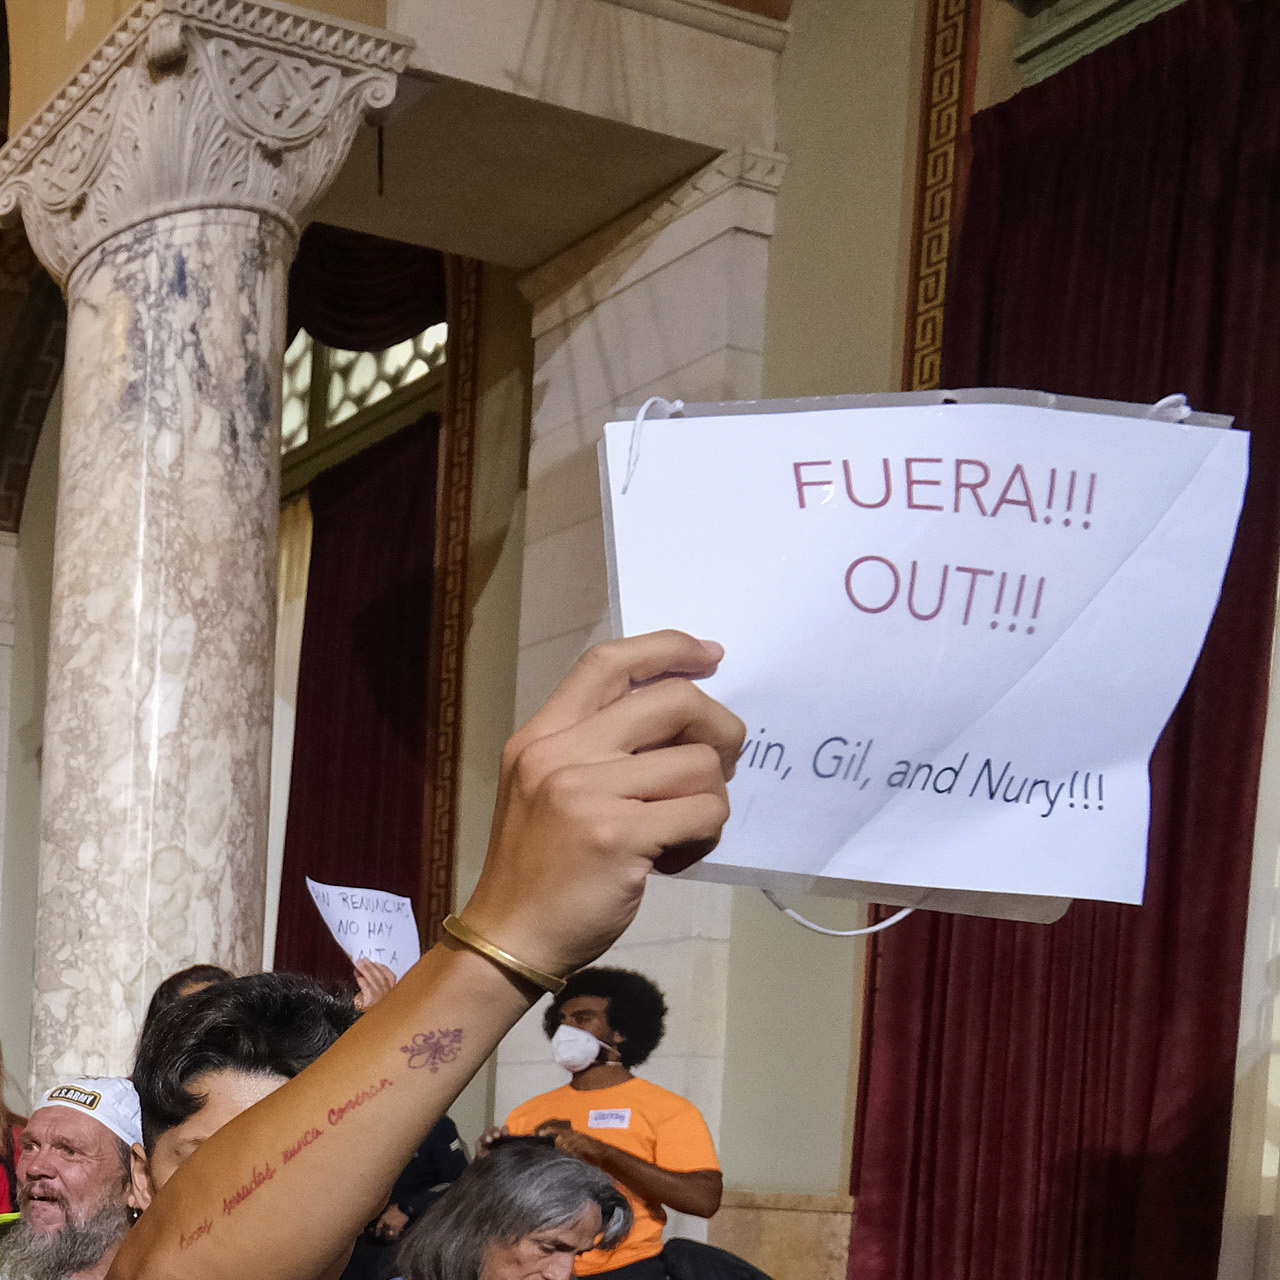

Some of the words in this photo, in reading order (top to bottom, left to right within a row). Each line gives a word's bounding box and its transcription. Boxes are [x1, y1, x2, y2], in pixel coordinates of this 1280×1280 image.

[793, 458, 1097, 530] FUERA!!!
[844, 555, 1045, 635] OUT!!!
[811, 736, 875, 791] Gil,
[886, 752, 968, 794] and
[969, 758, 1104, 817] Nury!!!
[338, 920, 359, 935] NO
[368, 922, 393, 939] HAY
[67, 1090, 94, 1105] ARMY
